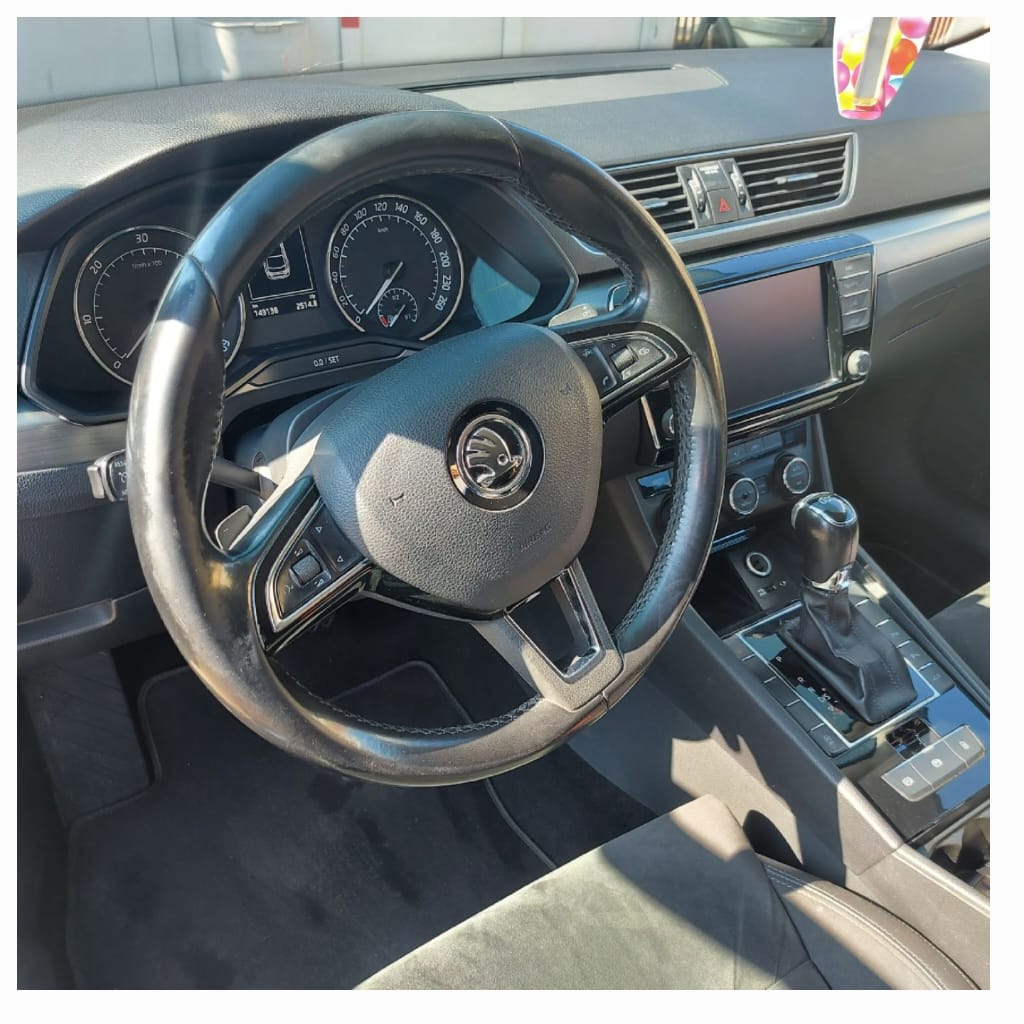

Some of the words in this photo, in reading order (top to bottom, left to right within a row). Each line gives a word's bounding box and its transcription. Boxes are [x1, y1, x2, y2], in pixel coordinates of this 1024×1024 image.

[354, 207, 367, 220] 100
[373, 201, 388, 212] 120
[395, 201, 409, 214] 140
[414, 210, 428, 226] 160
[340, 222, 350, 236] 80
[429, 227, 443, 245] 180
[135, 232, 149, 244] 30
[332, 245, 340, 259] 60
[439, 250, 451, 268] 200
[89, 259, 103, 274] 20
[332, 271, 339, 284] 40
[441, 274, 452, 292] 230
[435, 295, 448, 311] 260
[113, 360, 122, 369] 0
[328, 355, 340, 365] SET
